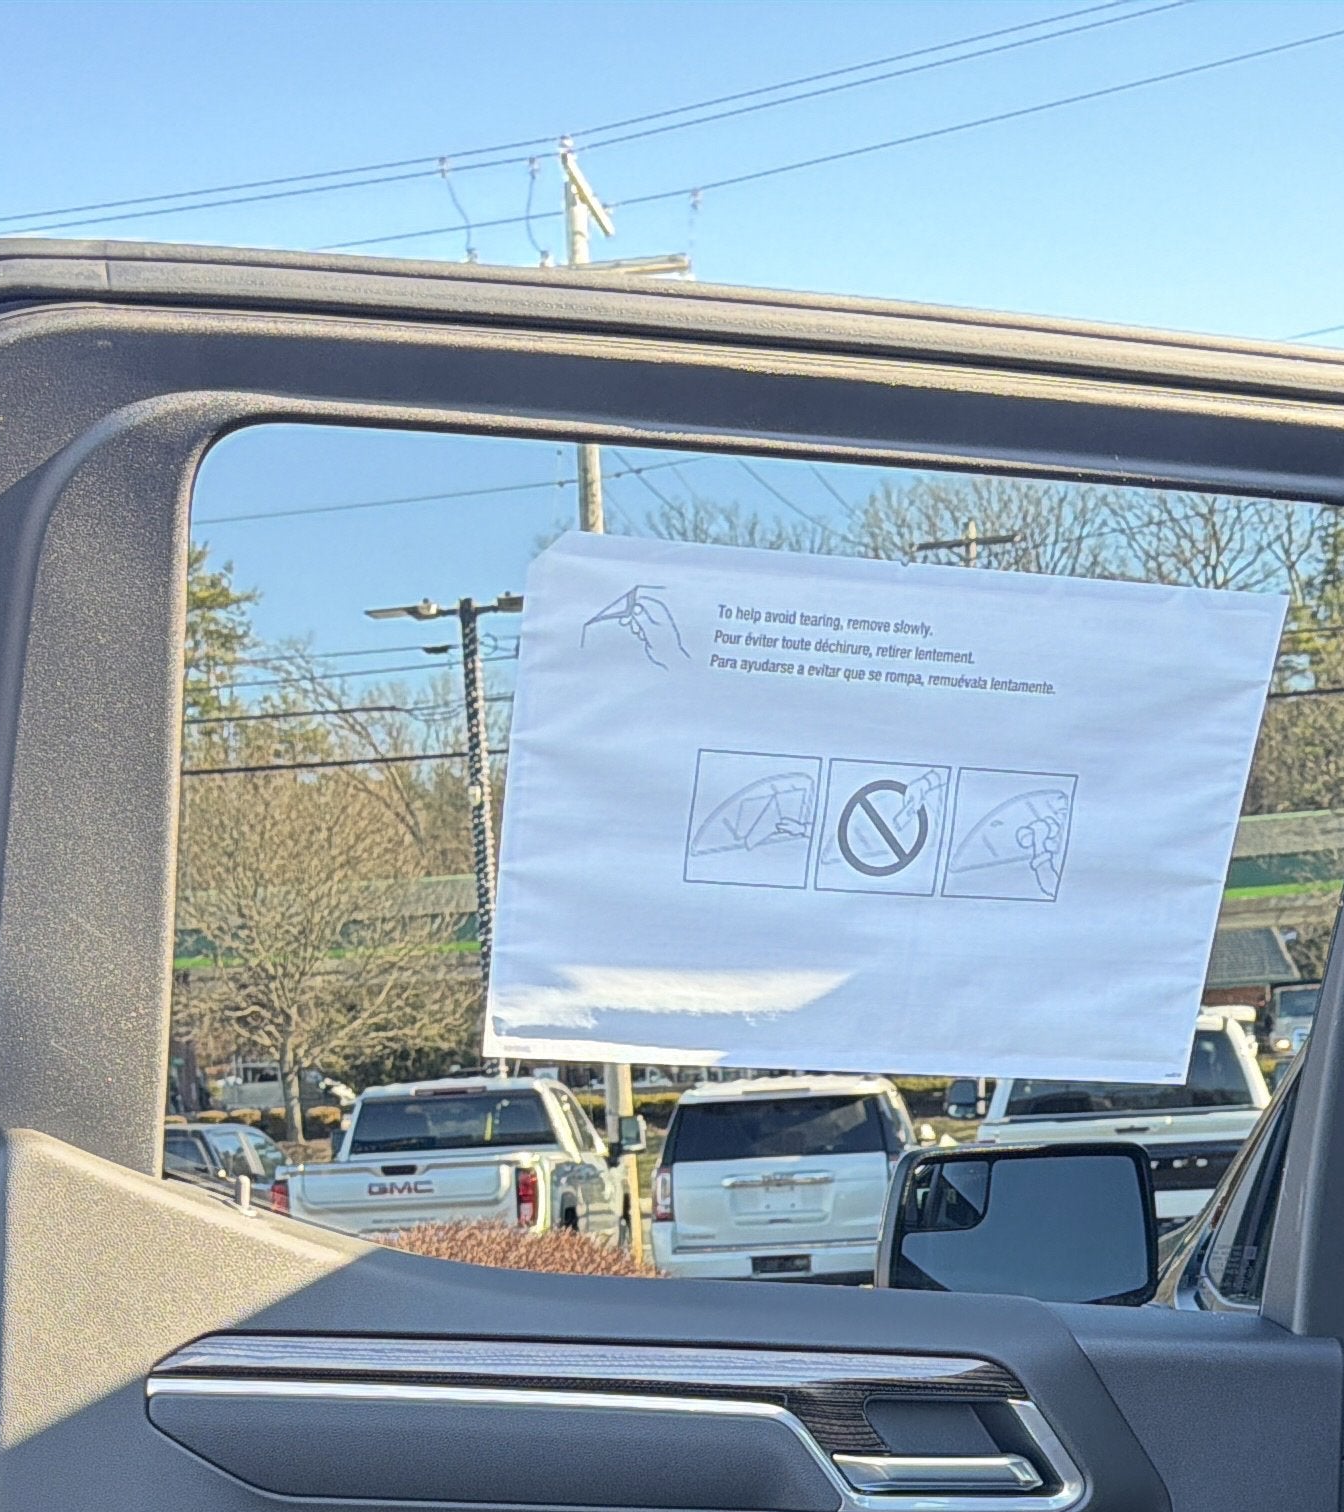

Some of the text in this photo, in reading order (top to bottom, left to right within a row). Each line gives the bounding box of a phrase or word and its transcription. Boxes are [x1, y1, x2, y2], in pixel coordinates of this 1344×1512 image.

[718, 604, 934, 638] To help avoid tearing, remove slowly.
[714, 629, 975, 665] Pour éviter toute déchirure, retirer lentement.
[709, 654, 1056, 695] Para ayudarse a evitar que se rompa, remuévala lentamente.
[367, 1180, 435, 1196] GMC
